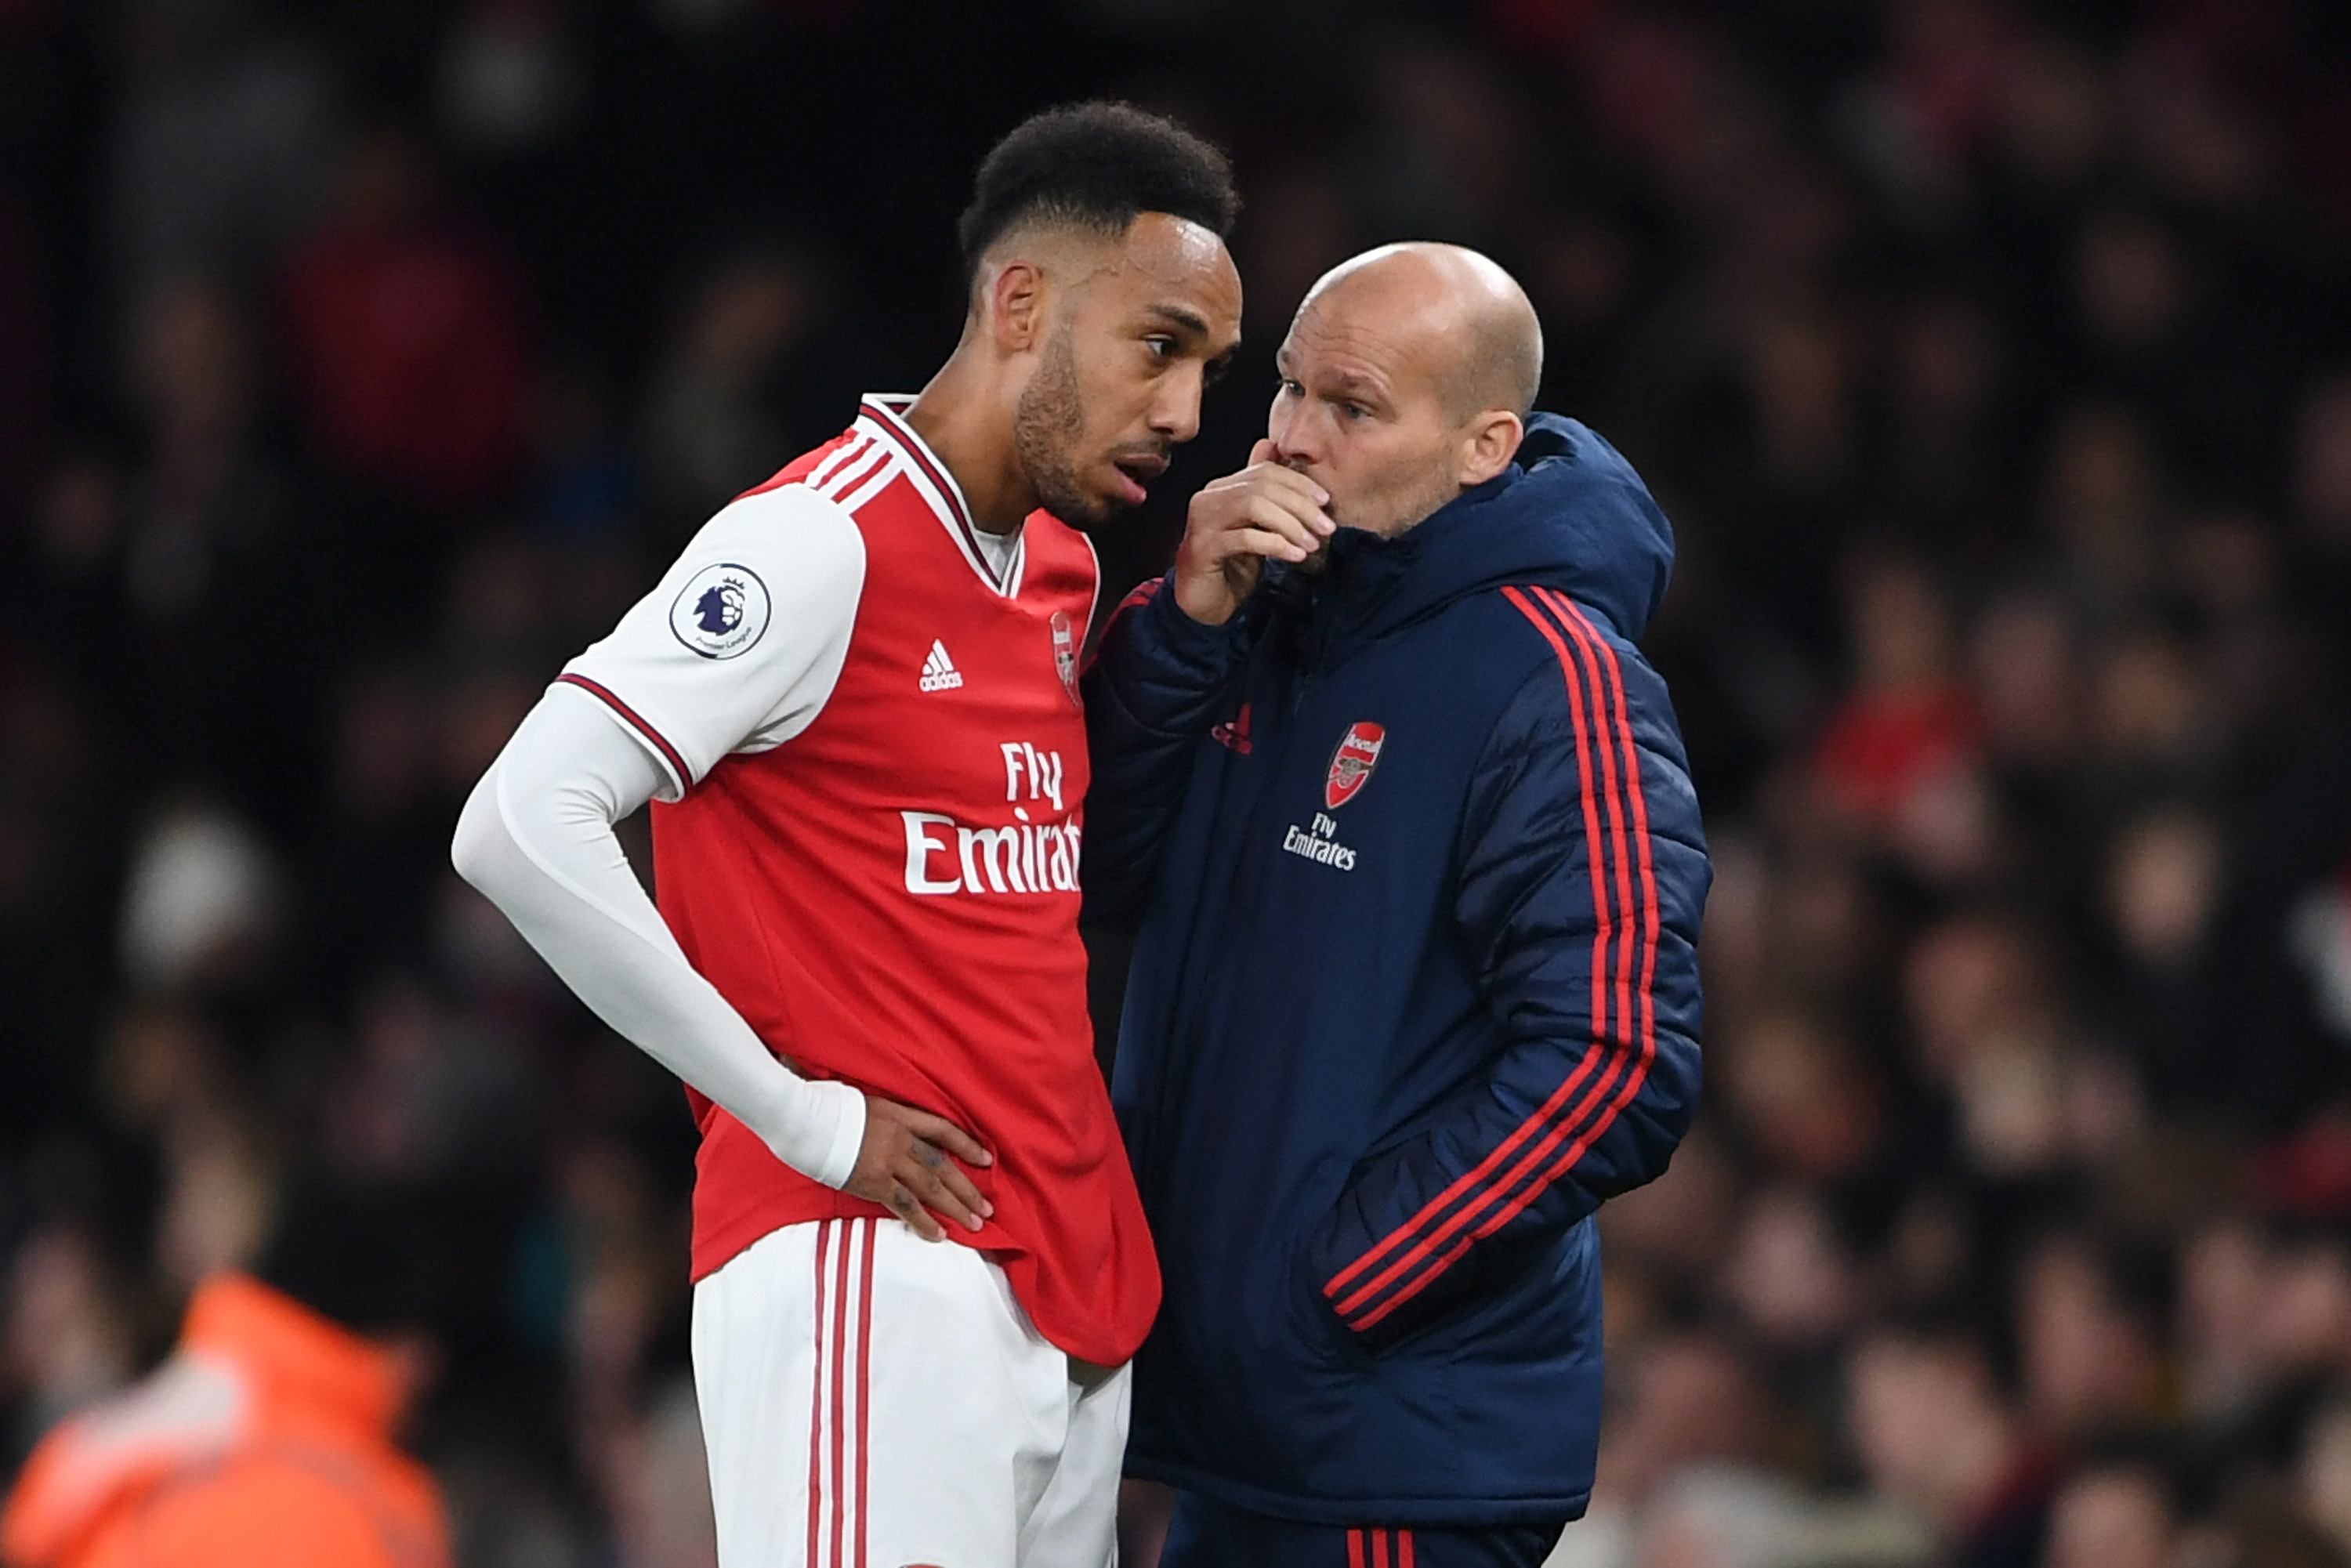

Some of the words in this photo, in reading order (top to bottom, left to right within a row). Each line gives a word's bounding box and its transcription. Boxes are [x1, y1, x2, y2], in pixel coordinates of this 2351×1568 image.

[918, 671, 963, 693] adidas
[1000, 741, 1063, 811] Fly
[1283, 824, 1357, 871] Emirates
[1311, 812, 1337, 839] Fly
[900, 806, 1081, 895] Emirat
